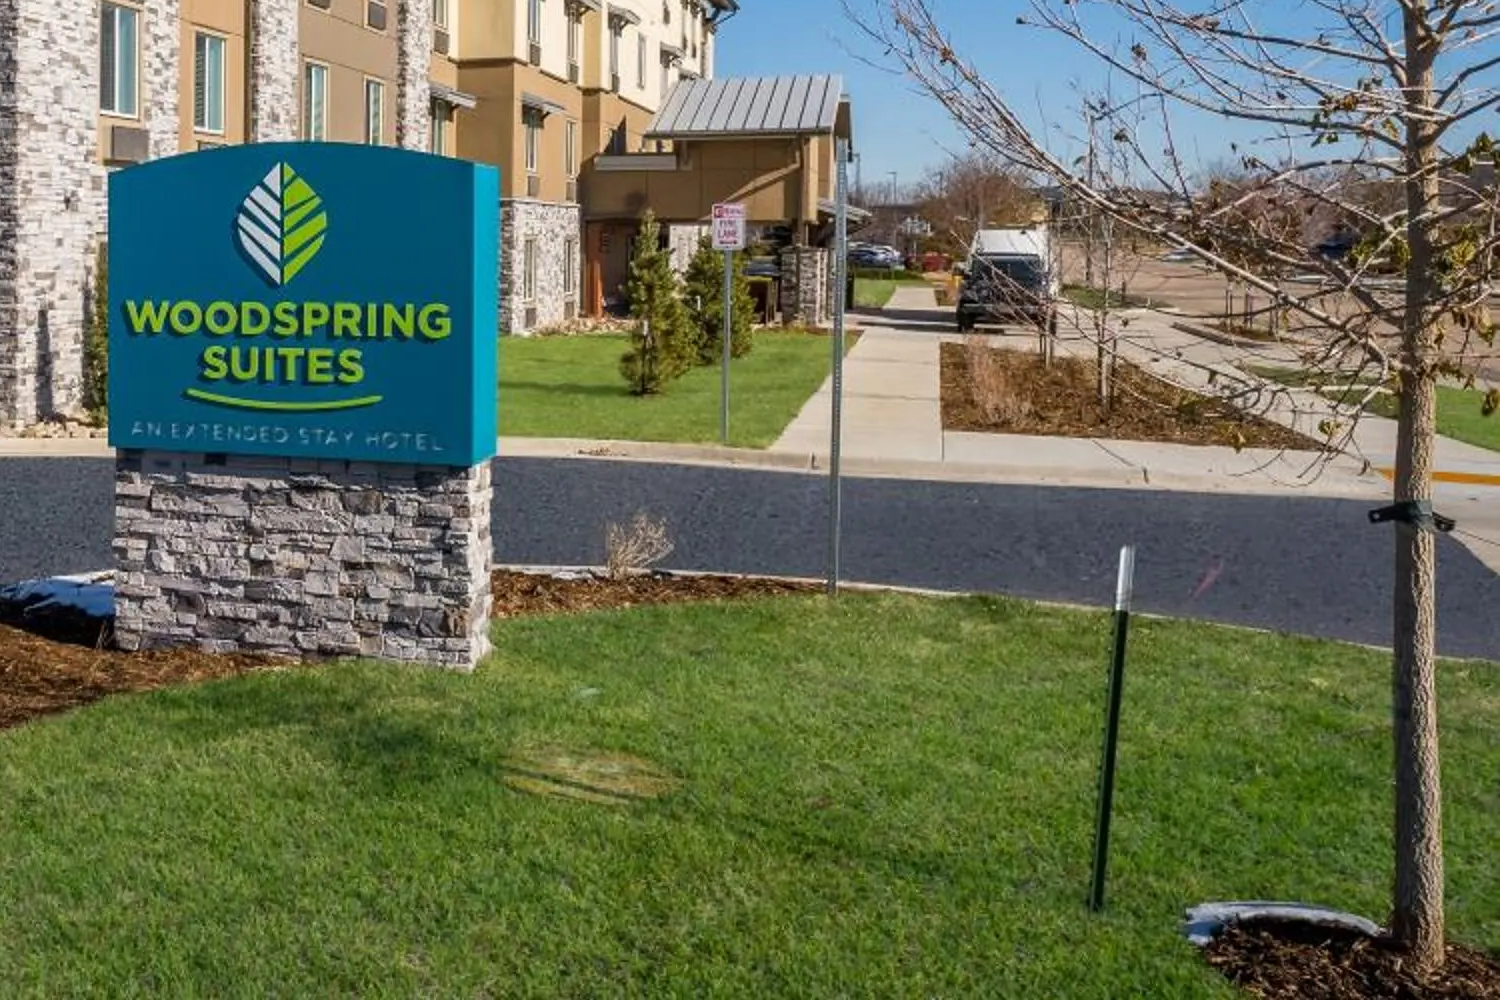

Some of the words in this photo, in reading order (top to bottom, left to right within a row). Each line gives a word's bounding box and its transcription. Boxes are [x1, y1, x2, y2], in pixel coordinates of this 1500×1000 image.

[126, 300, 452, 339] WOODSPRING
[203, 345, 364, 383] SUITES
[131, 421, 161, 437] AN
[171, 423, 290, 443] EXTENDED
[300, 428, 354, 445] STAY
[366, 431, 444, 451] HOTEL
